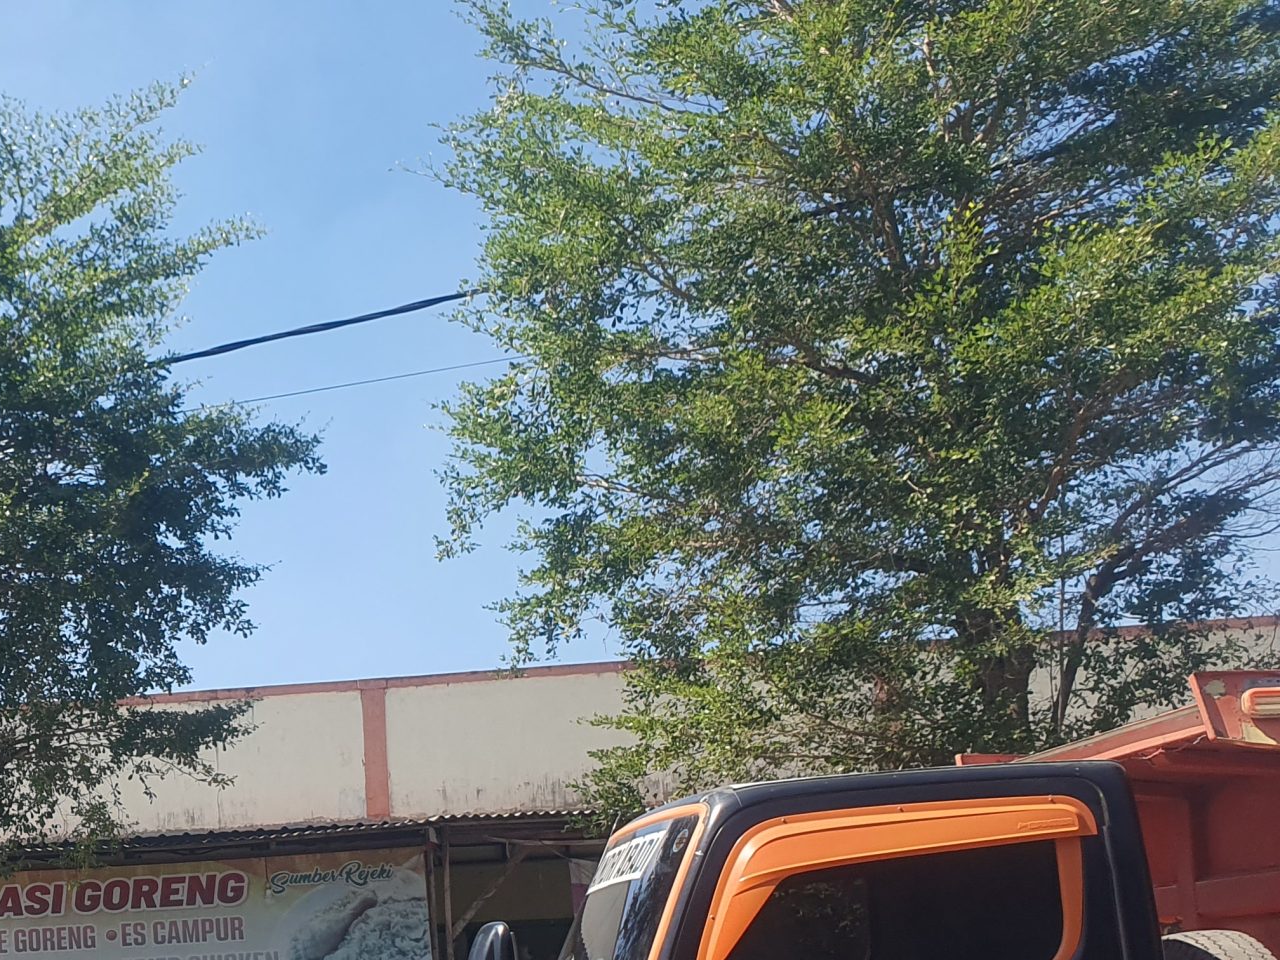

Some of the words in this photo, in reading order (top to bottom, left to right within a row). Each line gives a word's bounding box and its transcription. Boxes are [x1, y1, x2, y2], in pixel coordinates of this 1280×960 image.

[74, 873, 247, 913] GORENG
[271, 867, 338, 894] Sumber
[339, 862, 394, 886] Rejeki
[14, 925, 96, 952] GORENG
[121, 922, 146, 947] ES
[153, 917, 244, 943] CAMPUR
